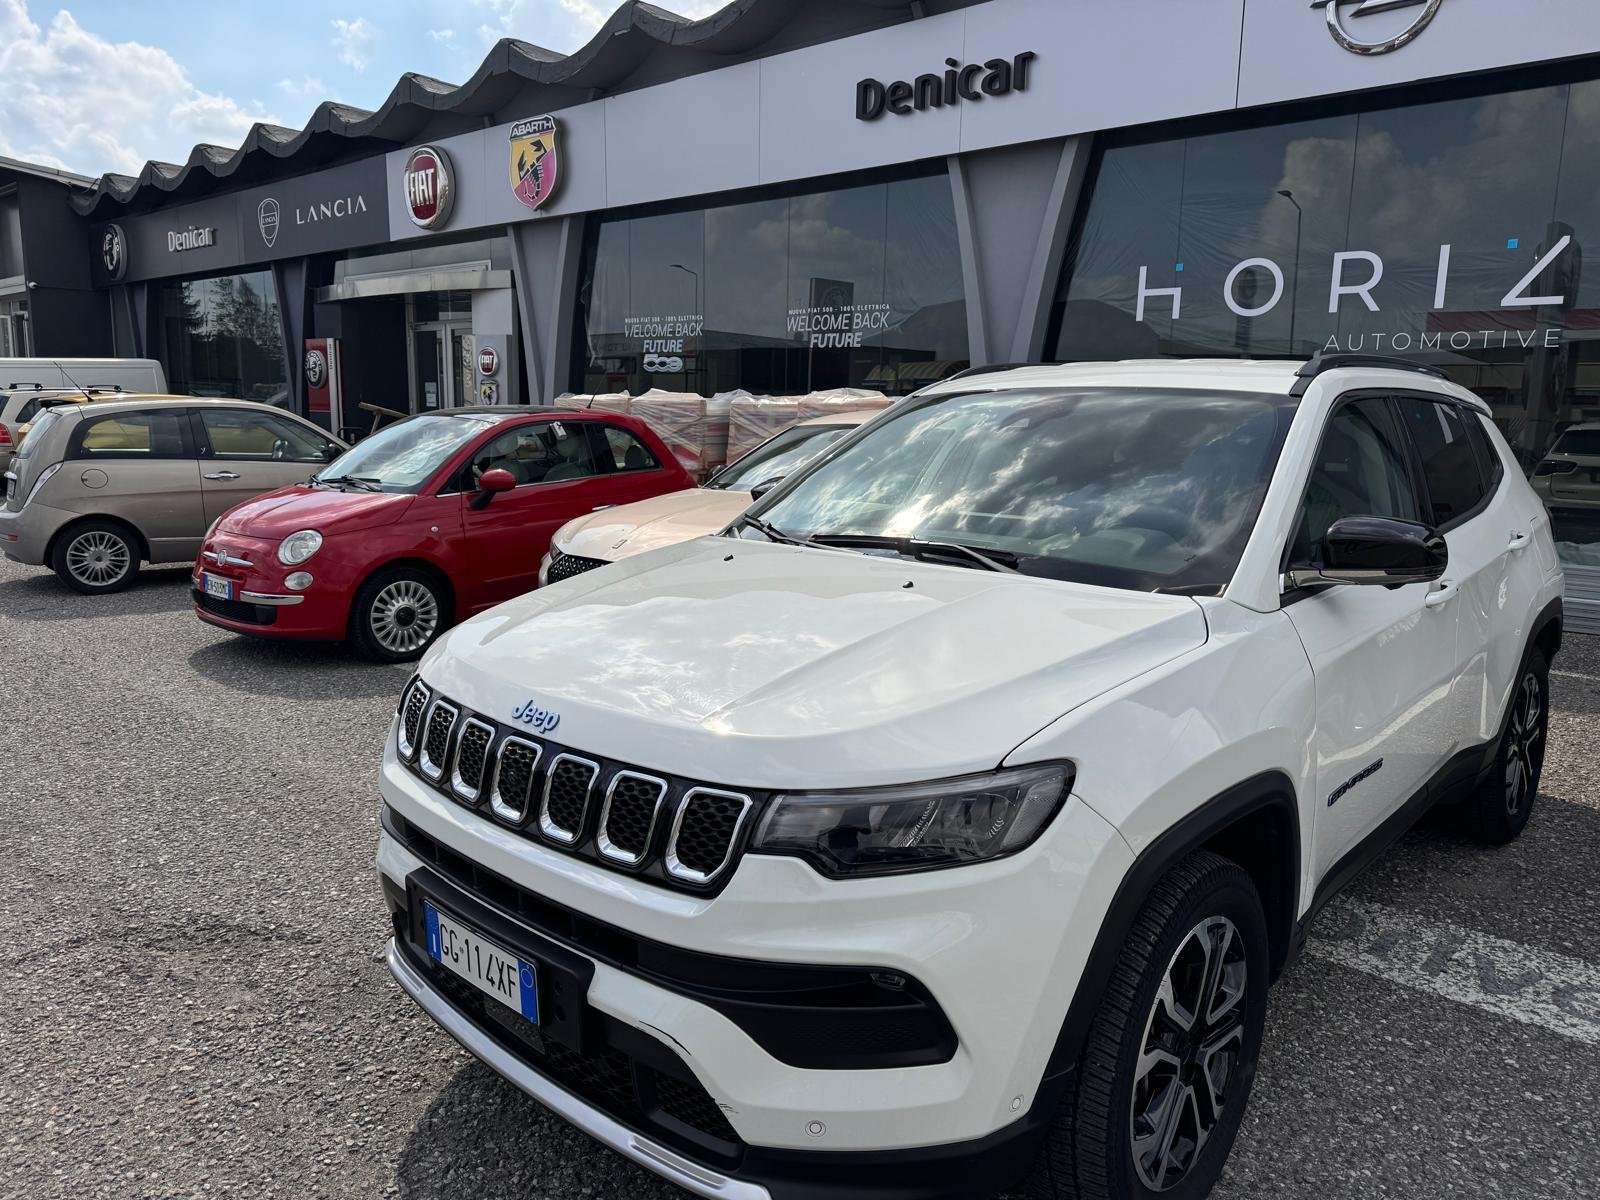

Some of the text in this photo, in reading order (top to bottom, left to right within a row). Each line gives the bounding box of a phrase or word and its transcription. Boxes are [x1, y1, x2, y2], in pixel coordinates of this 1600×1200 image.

[855, 50, 1036, 121] Denicar
[511, 120, 552, 138] ABARTH
[409, 168, 435, 207] FIAT
[296, 195, 367, 225] LANCIA
[167, 225, 213, 252] Denicar
[624, 322, 704, 338] WELCOME BACK
[786, 311, 890, 332] WELCOME BACK
[643, 339, 683, 353] FUTURE
[809, 332, 863, 348] FUTURE
[1322, 328, 1561, 352] AUTOMOTIVE
[511, 699, 560, 734] Jeep
